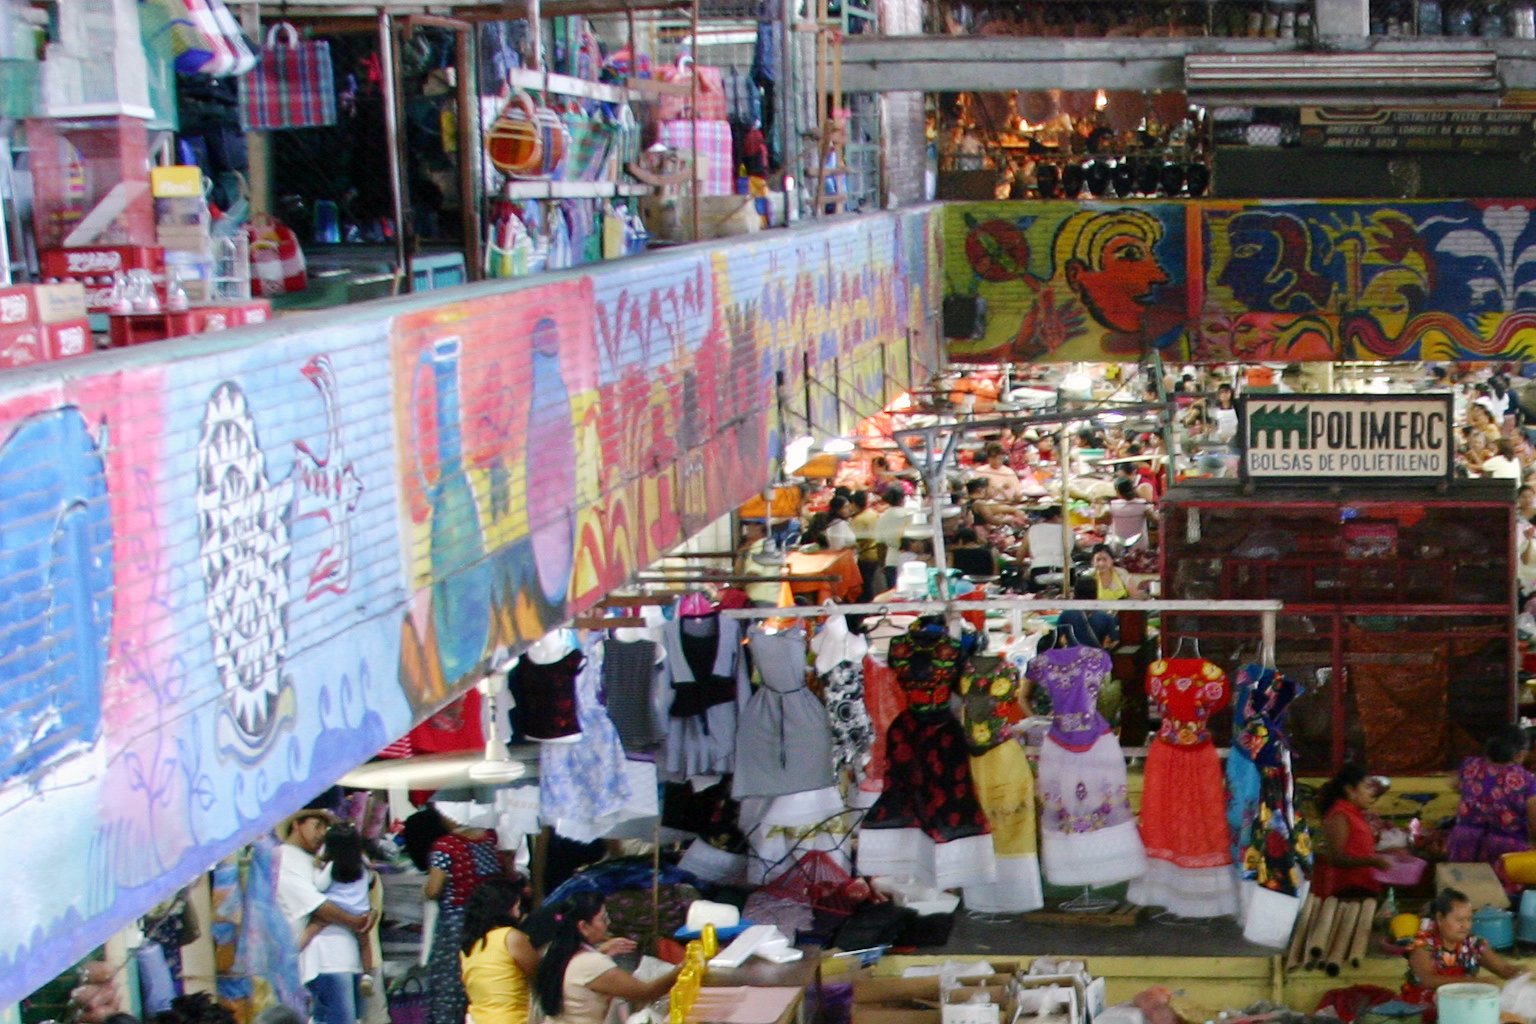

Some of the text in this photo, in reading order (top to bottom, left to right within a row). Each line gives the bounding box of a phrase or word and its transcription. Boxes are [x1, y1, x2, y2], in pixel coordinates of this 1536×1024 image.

[1311, 411, 1444, 449] POLIMERC
[1251, 453, 1440, 472] BOLSAS DE POLIETILENO
